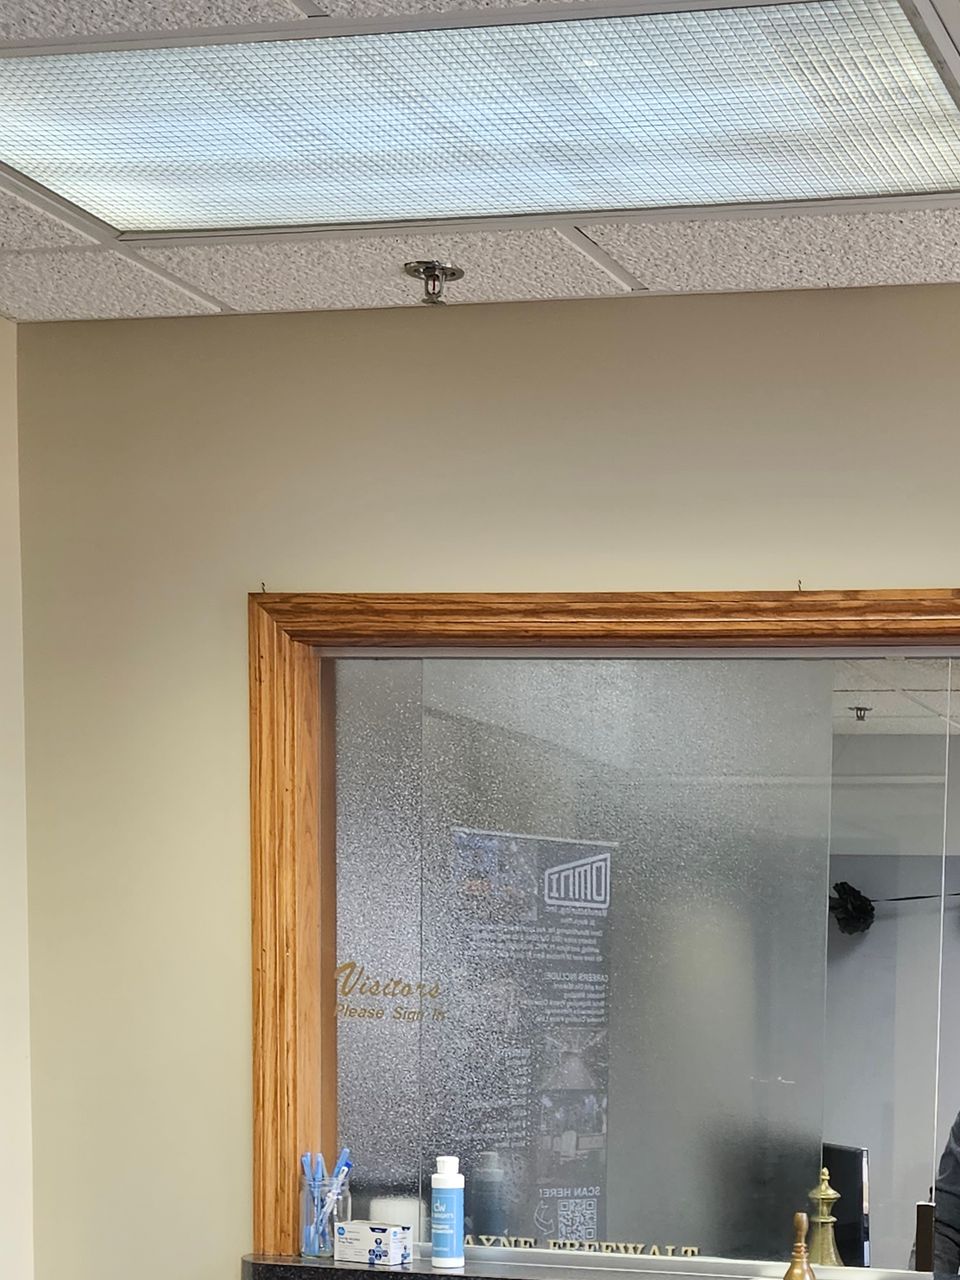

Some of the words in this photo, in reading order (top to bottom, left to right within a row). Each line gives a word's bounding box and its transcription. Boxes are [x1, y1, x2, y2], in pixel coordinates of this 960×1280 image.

[334, 961, 442, 998] Visitors
[334, 1003, 385, 1019] Please
[392, 1006, 425, 1022] Sign
[431, 1007, 448, 1021] In
